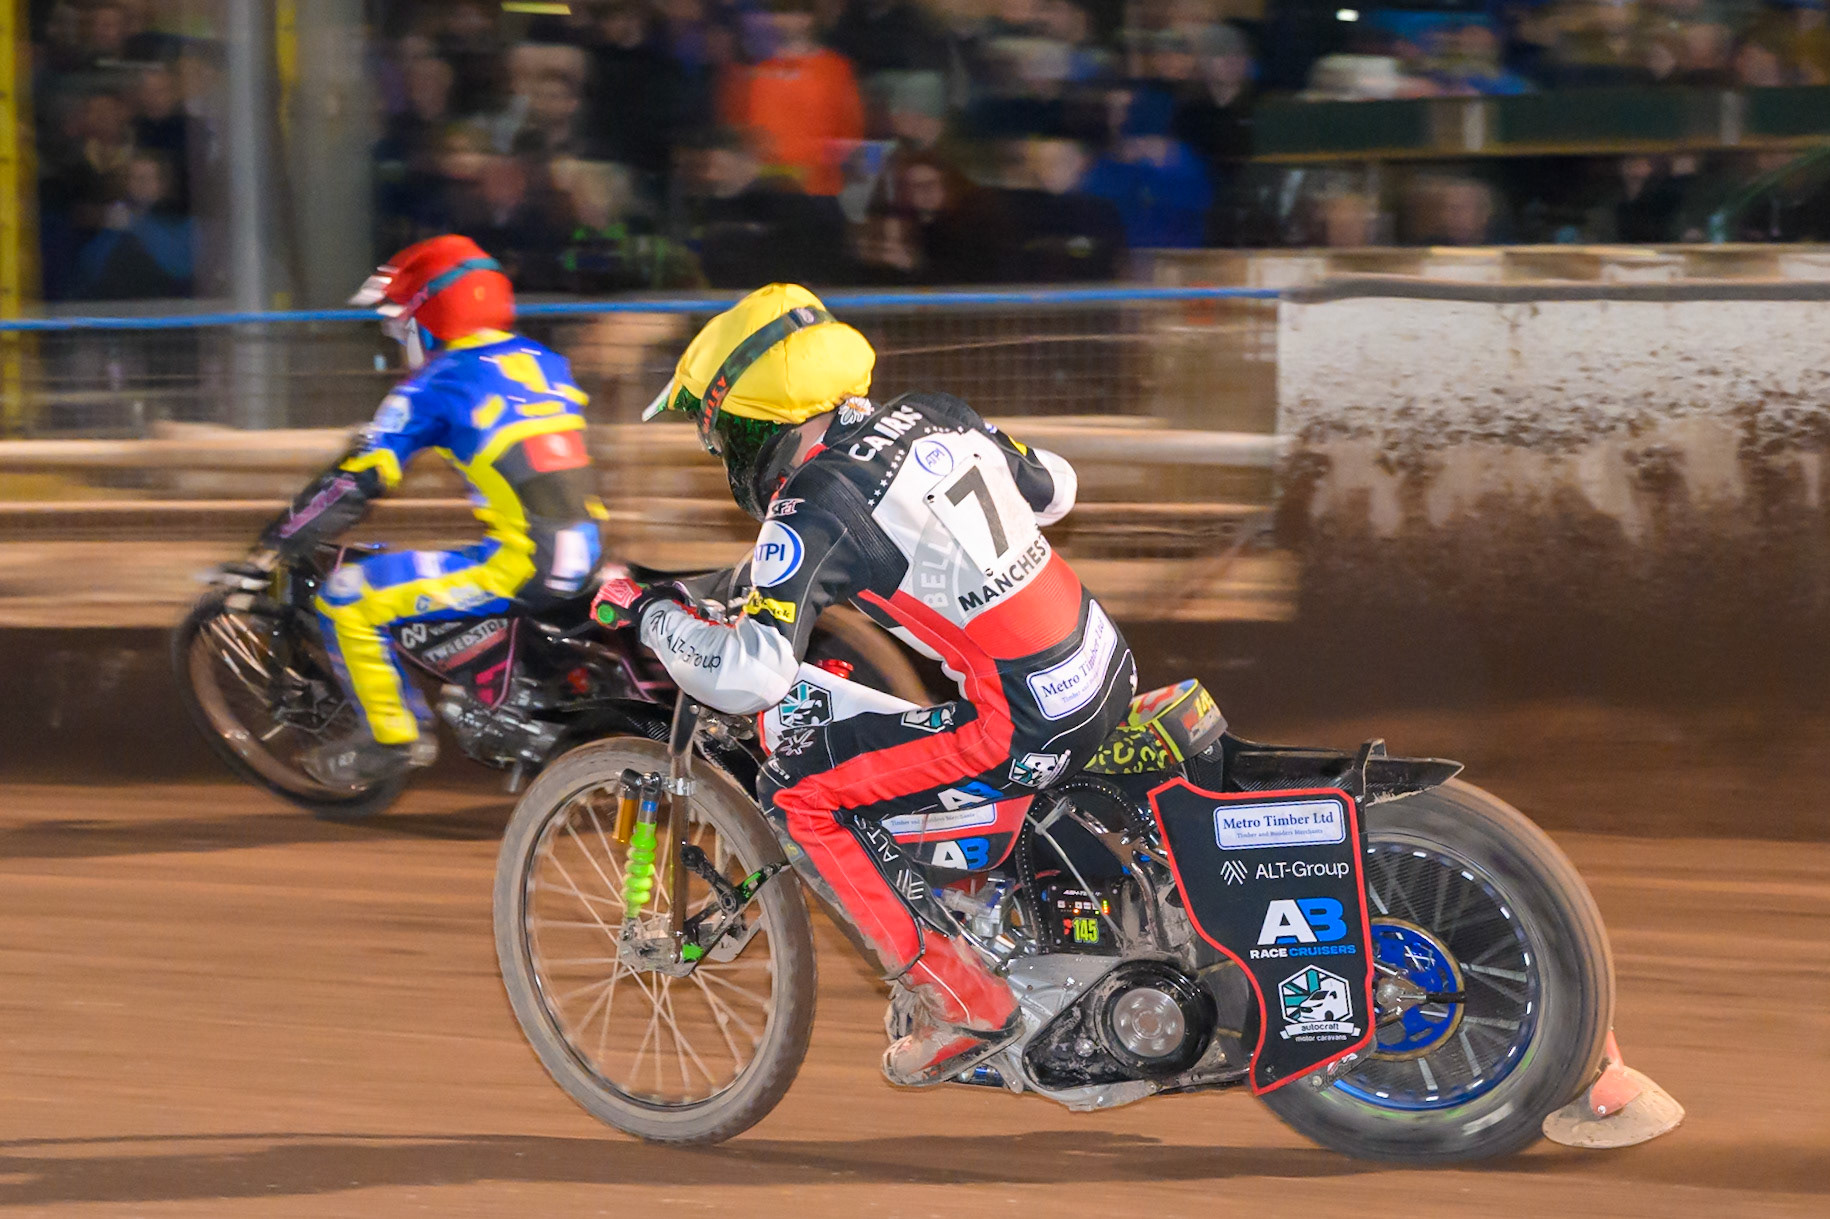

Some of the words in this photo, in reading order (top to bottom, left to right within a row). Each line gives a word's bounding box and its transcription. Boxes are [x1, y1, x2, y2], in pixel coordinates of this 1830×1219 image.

[944, 465, 1009, 559] 7
[958, 539, 1047, 612] MANCHES
[1041, 674, 1080, 698] Metro
[1223, 818, 1260, 829] Metro
[1263, 813, 1310, 827] Timber
[1312, 811, 1334, 824] Ltd
[931, 837, 990, 870] AB
[1255, 861, 1350, 880] ALT-Group
[1073, 917, 1099, 943] 145
[1257, 897, 1348, 945] AB
[1250, 948, 1288, 959] RACE
[1289, 944, 1356, 957] CRUISERS
[1301, 1022, 1339, 1032] autocraft
